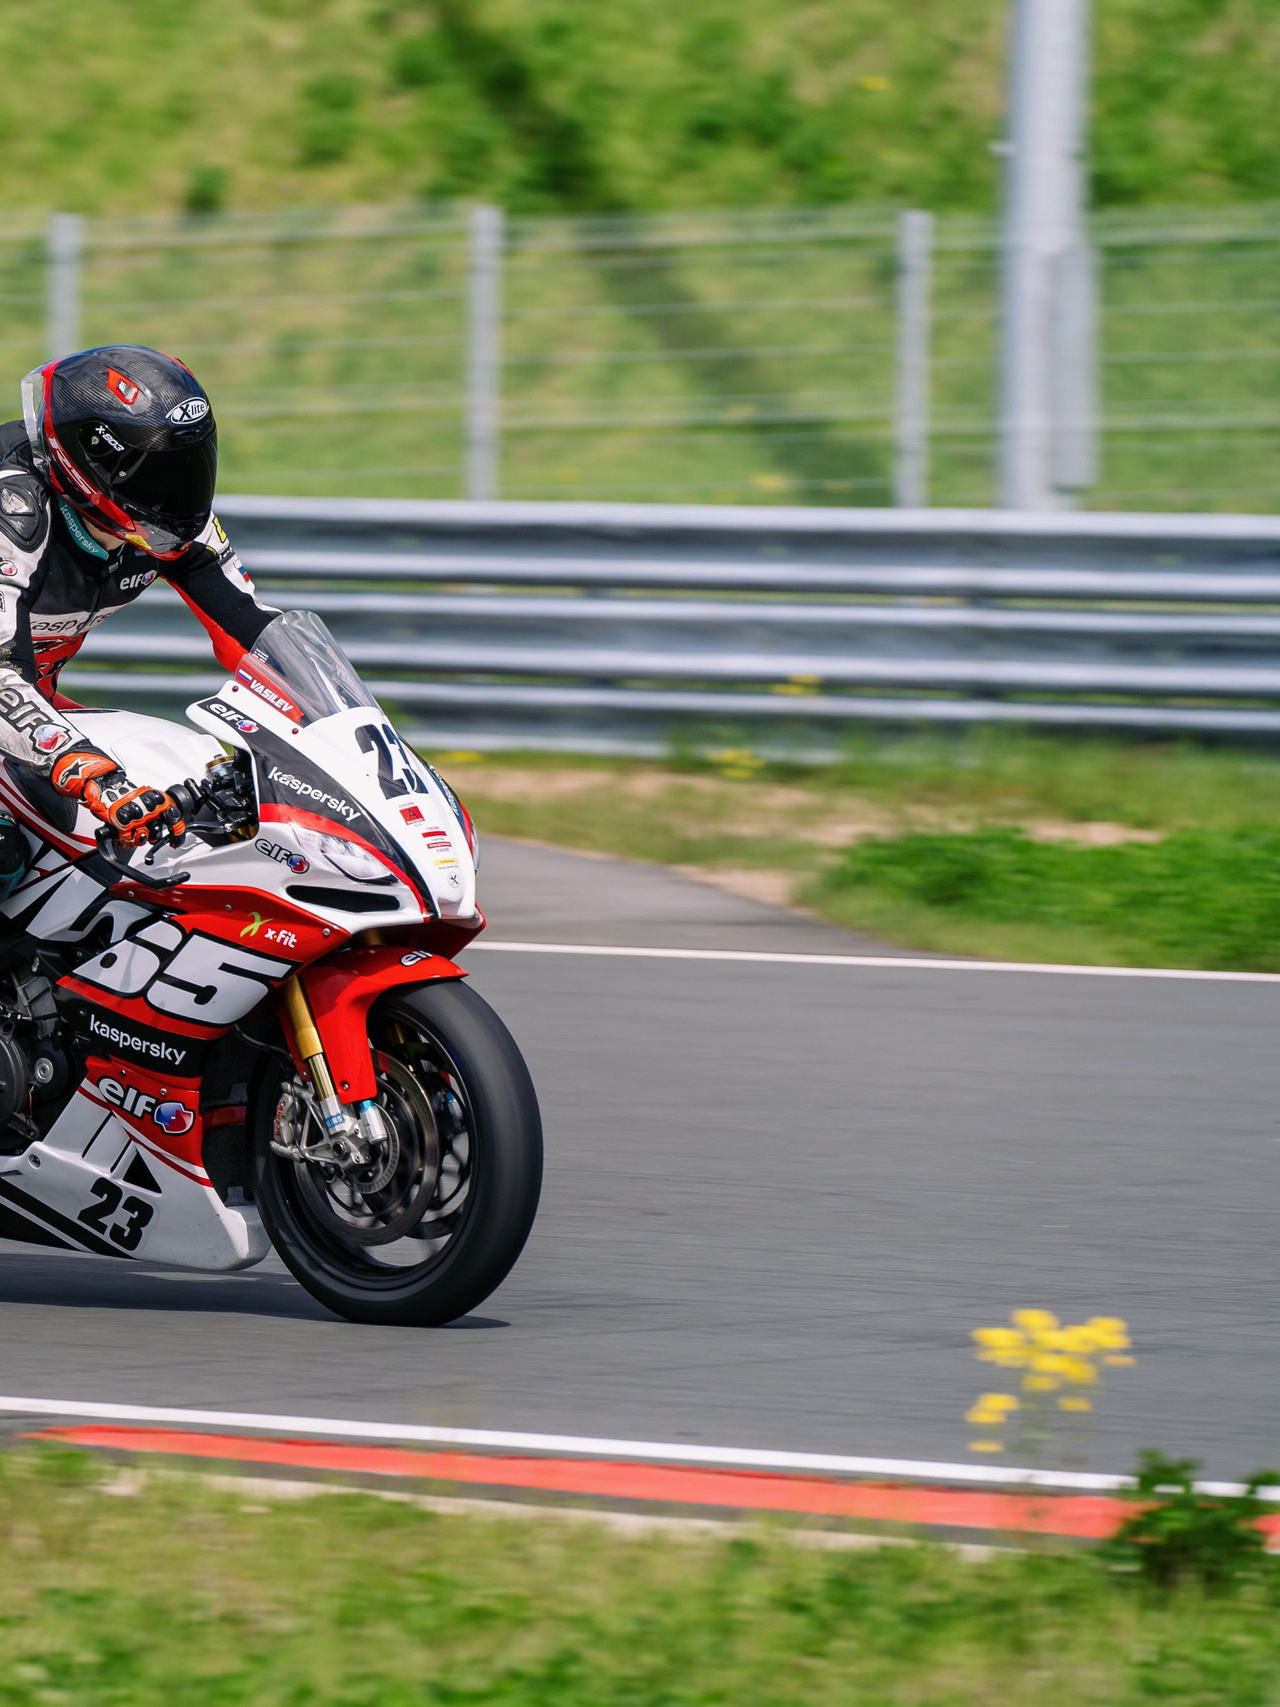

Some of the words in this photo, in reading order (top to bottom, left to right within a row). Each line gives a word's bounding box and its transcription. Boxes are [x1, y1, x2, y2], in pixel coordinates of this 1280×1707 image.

[60, 505, 99, 553] kaspersky
[120, 573, 144, 590] elf
[209, 703, 245, 723] elf
[249, 679, 294, 712] VASILEV
[269, 767, 361, 823] kaspersky
[256, 840, 291, 864] elf
[89, 1013, 187, 1065] kaspersky
[99, 1077, 157, 1119] elf
[77, 1177, 155, 1251] 23
